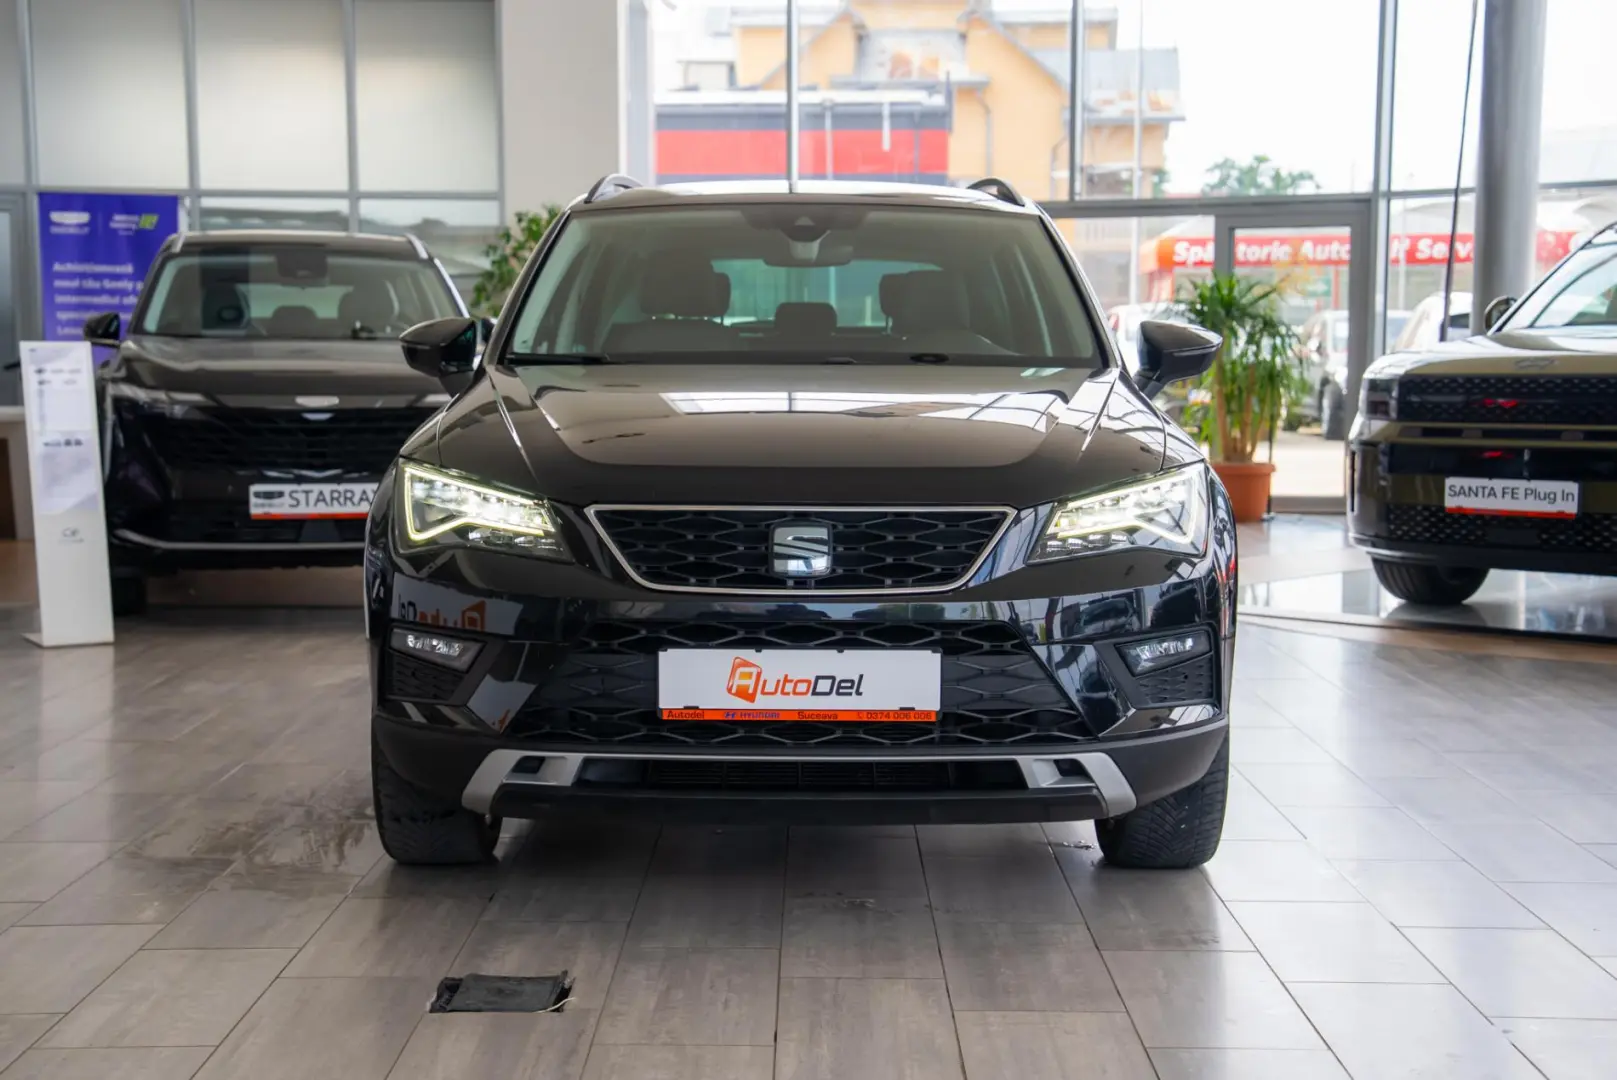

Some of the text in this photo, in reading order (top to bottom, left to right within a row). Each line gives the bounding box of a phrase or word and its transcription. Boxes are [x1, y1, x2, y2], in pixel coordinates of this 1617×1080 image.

[288, 488, 380, 508] STARRA
[1447, 484, 1576, 504] SANTA FE Plug In
[726, 656, 864, 704] AutoDel
[666, 710, 705, 719] Autodel
[797, 710, 839, 720] Suceava
[866, 711, 891, 720] 0374
